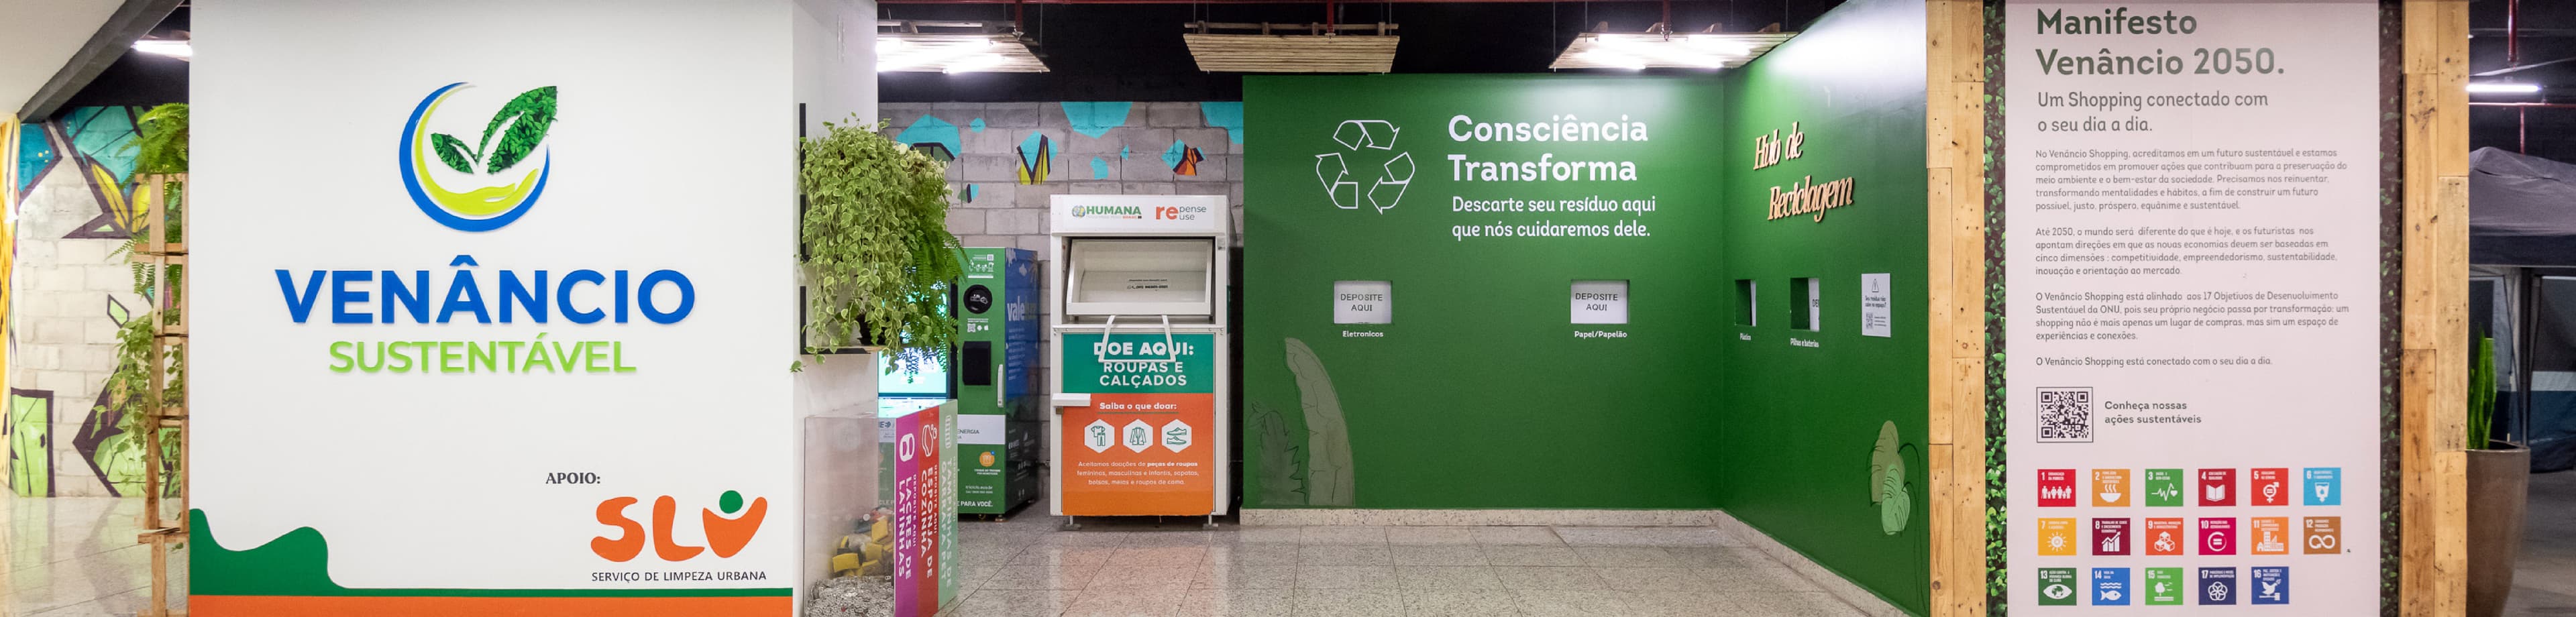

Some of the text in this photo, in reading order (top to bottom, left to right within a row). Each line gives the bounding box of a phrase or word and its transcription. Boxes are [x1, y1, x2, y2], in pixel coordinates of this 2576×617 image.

[2038, 7, 2196, 34] Manifesto
[2035, 48, 2284, 75] Venâncio 2050.
[2039, 91, 2268, 111] Um Shopping conectado com
[1448, 115, 1648, 142] Consciência
[2038, 115, 2152, 131] o seu dia a dia.
[1753, 121, 1804, 170] Hub de
[1448, 154, 1637, 182] Transforma
[2035, 187, 2100, 197] transformando
[2101, 187, 2159, 197] mentalidades
[2209, 187, 2223, 197] fim
[2224, 187, 2235, 197] de
[2237, 188, 2276, 197] construir
[2292, 186, 2319, 197] futuro
[1767, 175, 1854, 223] Reciclagem
[1086, 206, 1142, 215] HUMANA
[1179, 206, 1207, 214] pense
[1452, 195, 1656, 217] Descarte seu resíduo aqui
[1452, 219, 1650, 241] que nós cuidaremos dele.
[2035, 227, 2051, 236] Até
[2084, 226, 2114, 236] mundo
[2115, 227, 2134, 236] será
[2137, 226, 2176, 236] diferente
[2178, 226, 2189, 236] do
[2190, 229, 2206, 238] que
[2206, 227, 2212, 235] é
[2253, 226, 2296, 235] futuristas
[275, 255, 695, 325] VENÂNCIO
[1575, 293, 1618, 301] DEPOSITE
[1574, 331, 1627, 339] Papel/Papelão
[329, 333, 636, 373] SUSTENTÁVEL
[1093, 342, 1133, 355] DOE
[1104, 361, 1183, 373] ROUPAS E
[2035, 357, 2043, 366] O
[2044, 357, 2083, 366] Venâncio
[2084, 356, 2125, 368] Shopping
[2126, 357, 2145, 366] está
[2146, 356, 2191, 366] conectado
[2235, 356, 2249, 366] dia
[1099, 374, 1187, 388] CALÇADOS
[1099, 402, 1125, 410] Saiba
[1153, 402, 1177, 410] doar:
[2104, 400, 2150, 412] Conheça
[2104, 414, 2202, 427] ações sustentáveis
[545, 472, 600, 484] APOIO:
[2095, 471, 2100, 480] 2
[2148, 471, 2153, 480] 3
[2201, 471, 2206, 480] 4
[2253, 471, 2259, 480] 5
[2306, 471, 2312, 480] 6
[977, 499, 994, 507] VOCÊ.
[2041, 520, 2045, 529] 7
[2095, 520, 2100, 530] 8
[2148, 520, 2153, 529] 9
[2200, 520, 2208, 529] 10
[2253, 520, 2259, 528] 11
[2306, 519, 2313, 528] 12
[906, 555, 912, 579] DE
[927, 556, 933, 578] DE
[592, 571, 766, 583] SERVIÇO DE LIMPEZA URBANA
[947, 566, 952, 587] DE
[2040, 570, 2048, 579] 13
[2094, 570, 2102, 579] 14
[2201, 570, 2208, 579] 17
[2253, 569, 2261, 578] 16
